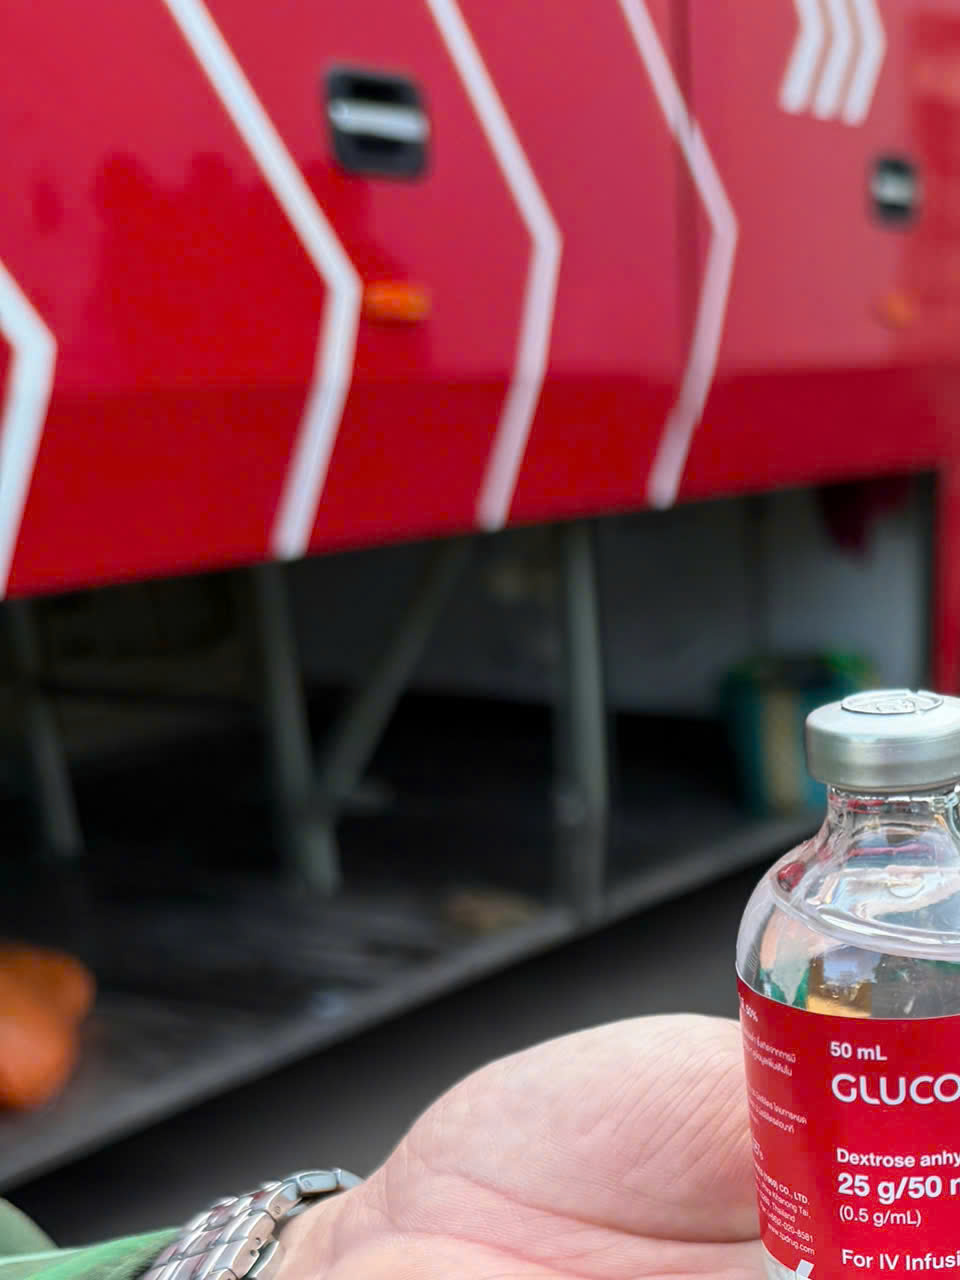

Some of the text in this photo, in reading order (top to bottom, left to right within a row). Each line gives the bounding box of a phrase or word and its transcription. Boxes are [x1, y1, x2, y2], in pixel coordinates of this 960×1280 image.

[830, 1041, 888, 1061] 50 mL
[836, 1147, 916, 1168] Dextrose
[837, 1172, 870, 1197] 25
[877, 1175, 943, 1205] g/50
[839, 1204, 922, 1228] (0.5 g/mL)
[842, 1248, 874, 1269] For
[879, 1253, 900, 1271] IV
